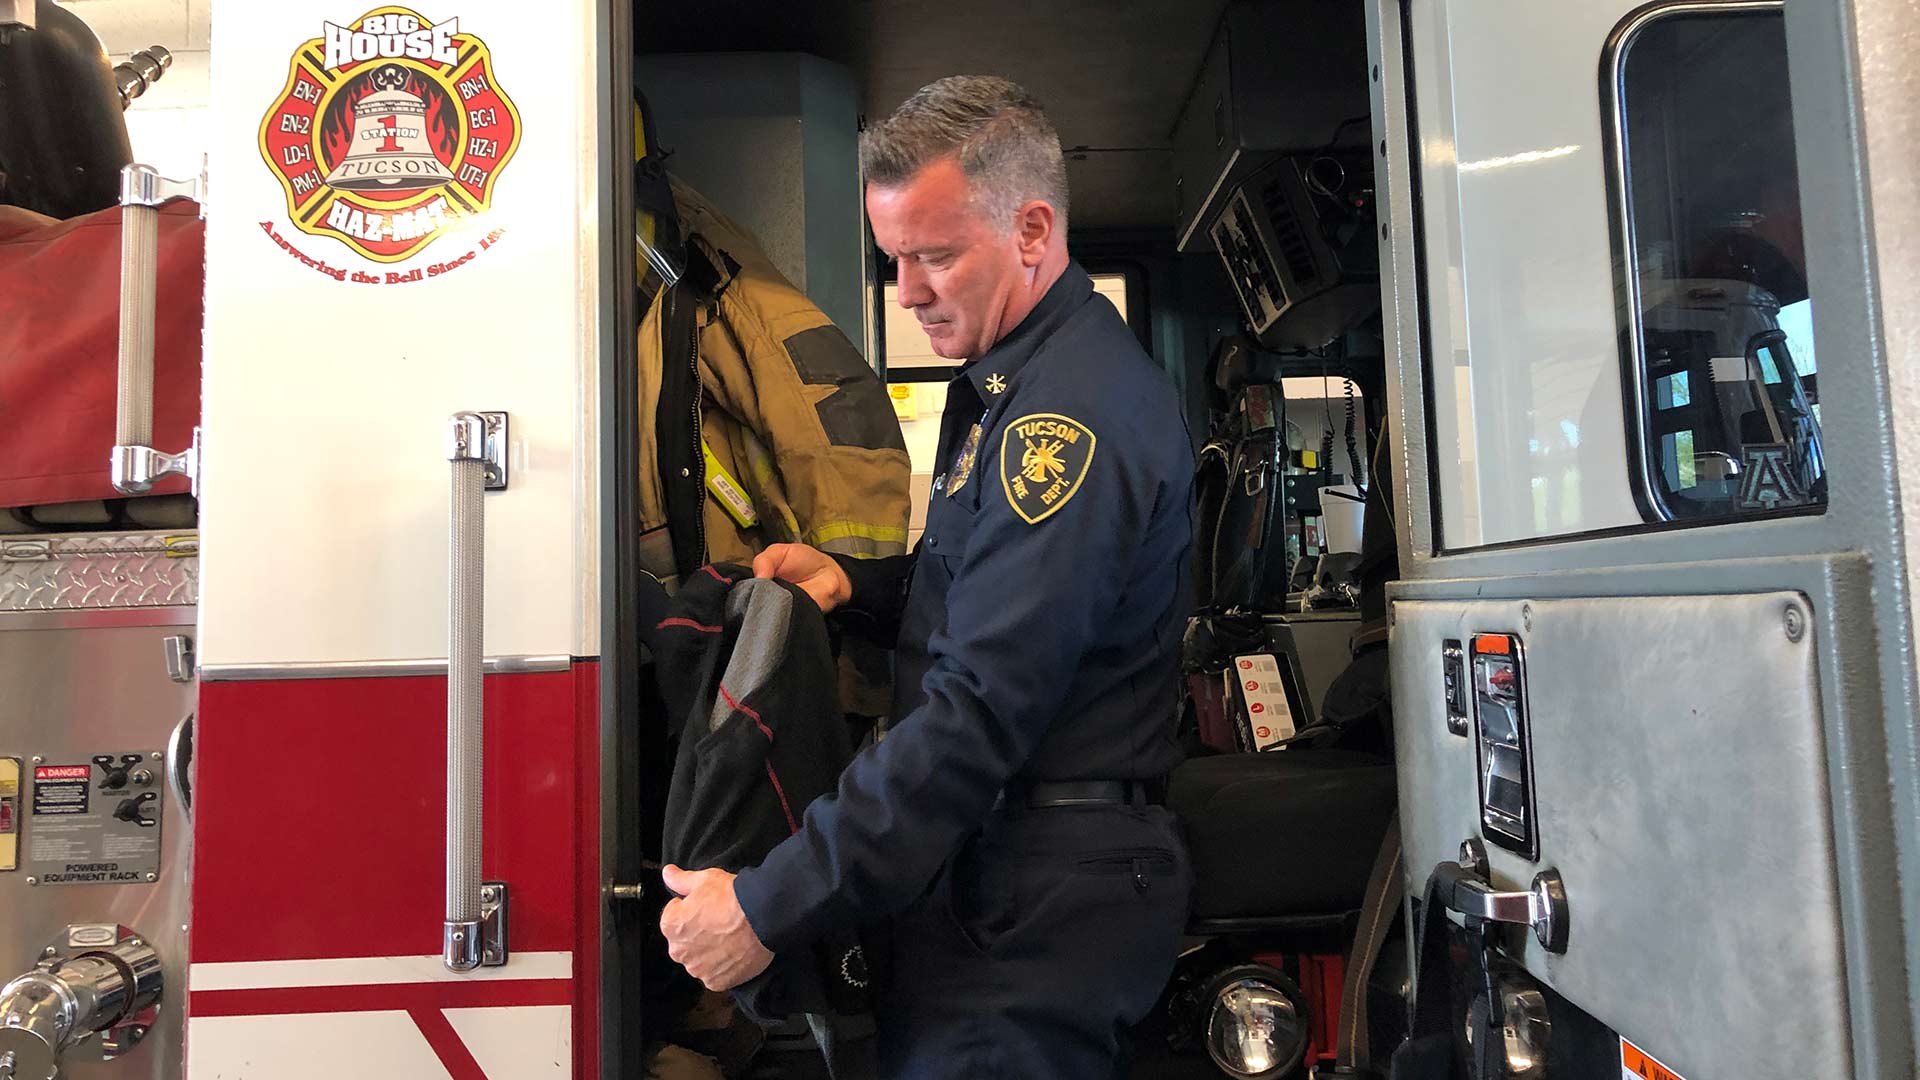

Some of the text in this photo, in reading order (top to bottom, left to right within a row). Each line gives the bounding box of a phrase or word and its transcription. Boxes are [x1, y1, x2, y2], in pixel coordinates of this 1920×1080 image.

[363, 14, 419, 35] BIG
[324, 16, 458, 71] HOUSE
[292, 79, 322, 106] EN-1
[459, 74, 489, 101] BN-1
[280, 113, 310, 135] EN-2
[469, 107, 497, 128] EC-1
[361, 127, 419, 140] STATION
[375, 114, 404, 152] 1
[283, 143, 311, 166] LD-1
[468, 137, 498, 158] HZ-1
[340, 160, 440, 177] TUCSON
[459, 163, 488, 189] UT-1
[292, 168, 322, 195] PM-1
[326, 195, 449, 242] HAZ-MAT
[259, 220, 347, 281] Answering
[351, 271, 380, 284] the
[385, 268, 423, 284] Bell
[427, 250, 476, 278] Since
[1016, 421, 1081, 445] TUCSON
[1011, 476, 1071, 505] FIRE DEPT.
[47, 768, 86, 777] DANGER
[43, 871, 140, 883] EQUIPMENT RACK
[65, 863, 119, 873] POWERED
